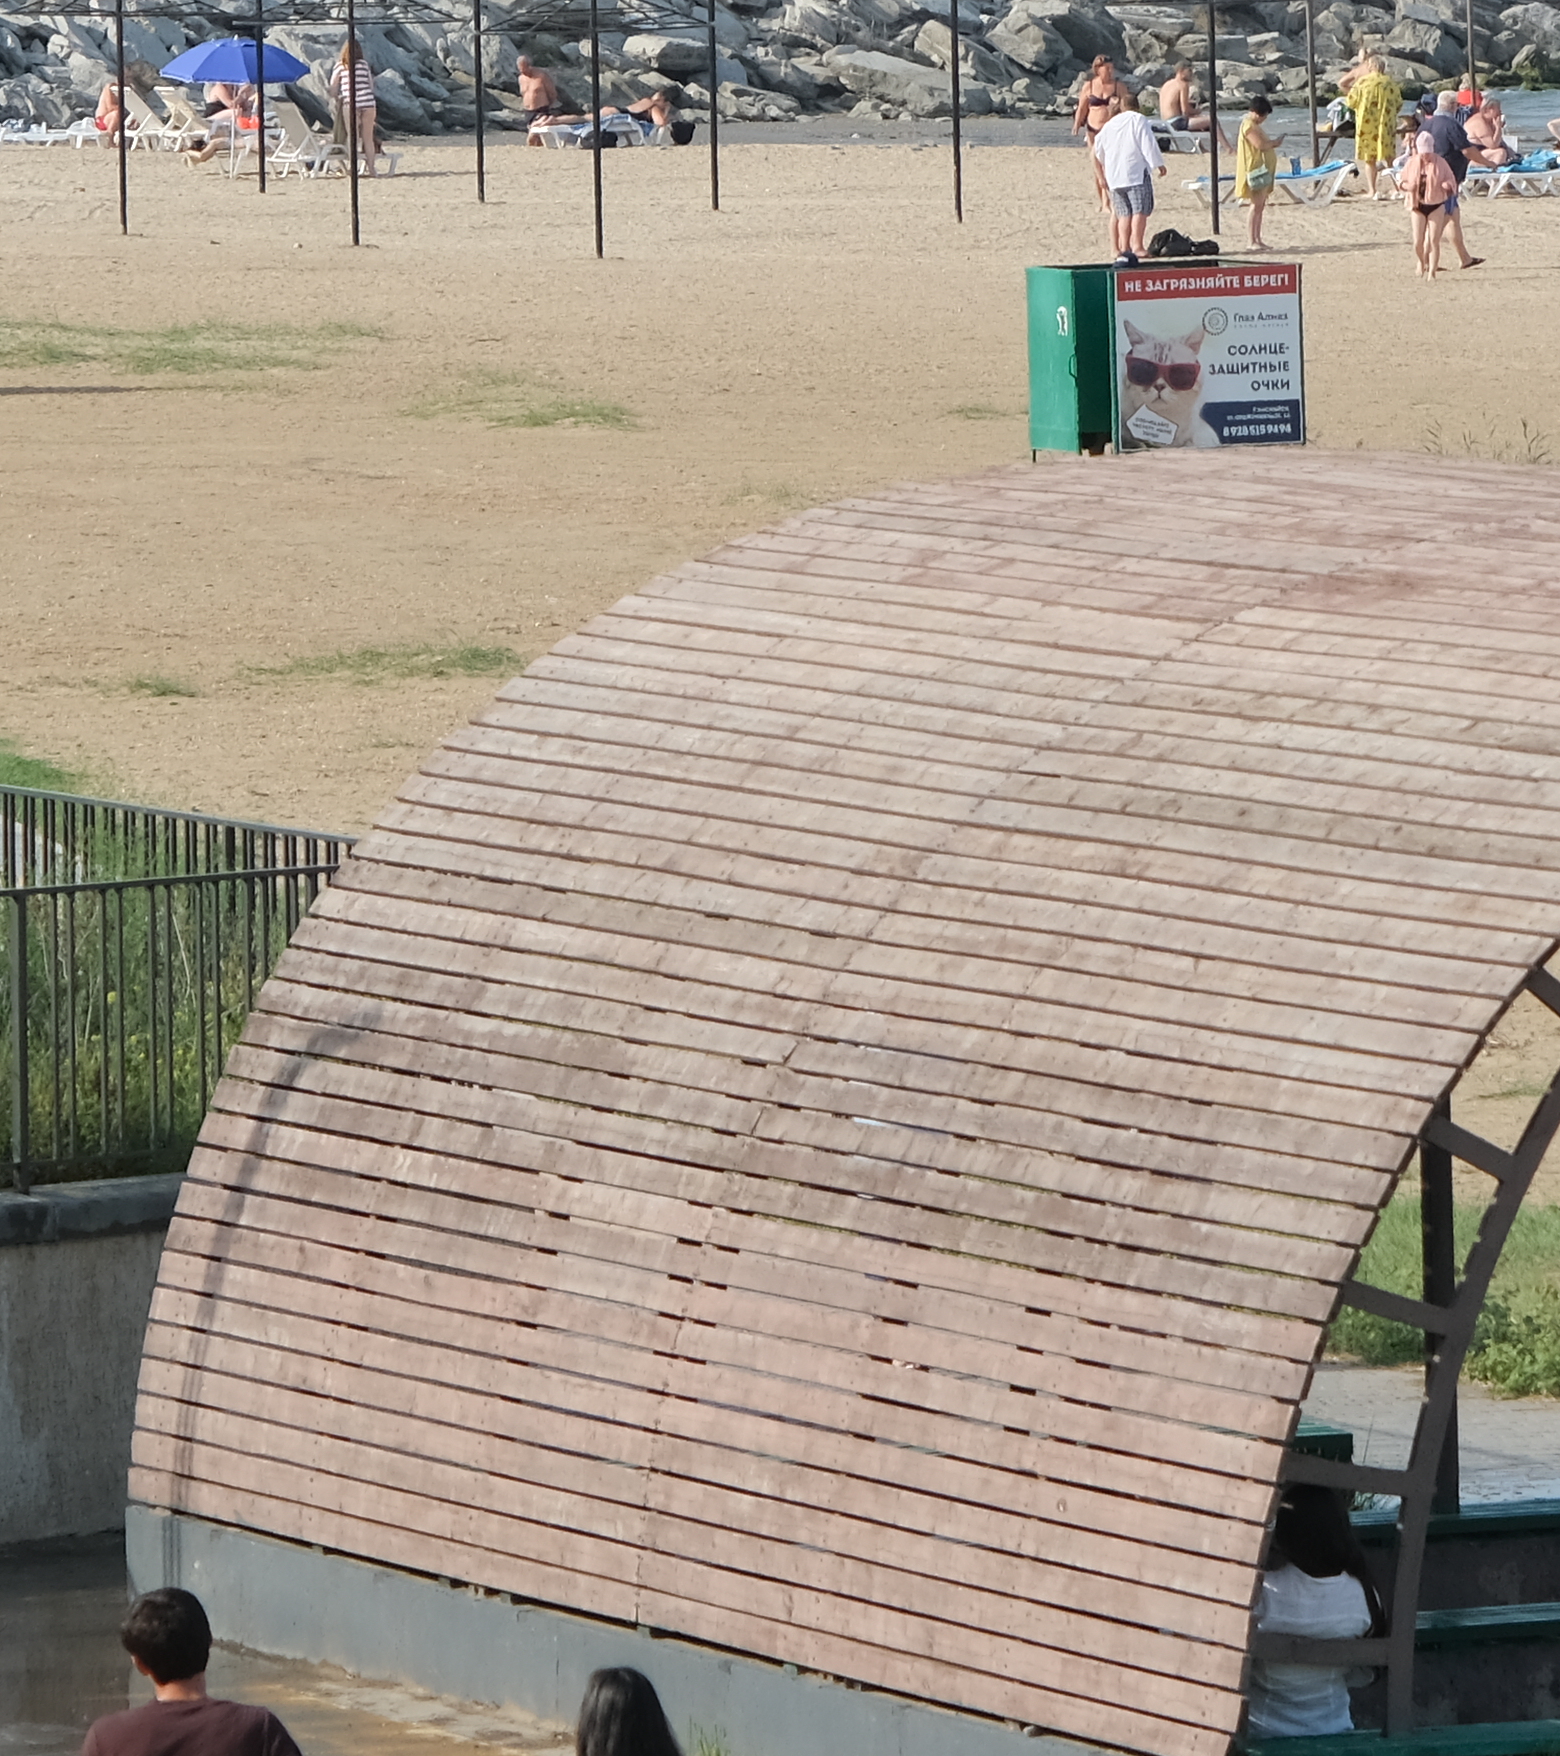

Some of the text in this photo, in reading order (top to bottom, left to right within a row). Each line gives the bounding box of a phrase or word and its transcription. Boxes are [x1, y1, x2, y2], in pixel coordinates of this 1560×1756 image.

[1124, 273, 1289, 292] НЕ ЗАГРЯЗНЯЙТЕ БЕРЕГ!
[1227, 342, 1290, 356] СОЛНЦЕ-
[1208, 361, 1290, 375] ЗАЩИТНЫЕ
[1250, 379, 1290, 392] ОЧКИ
